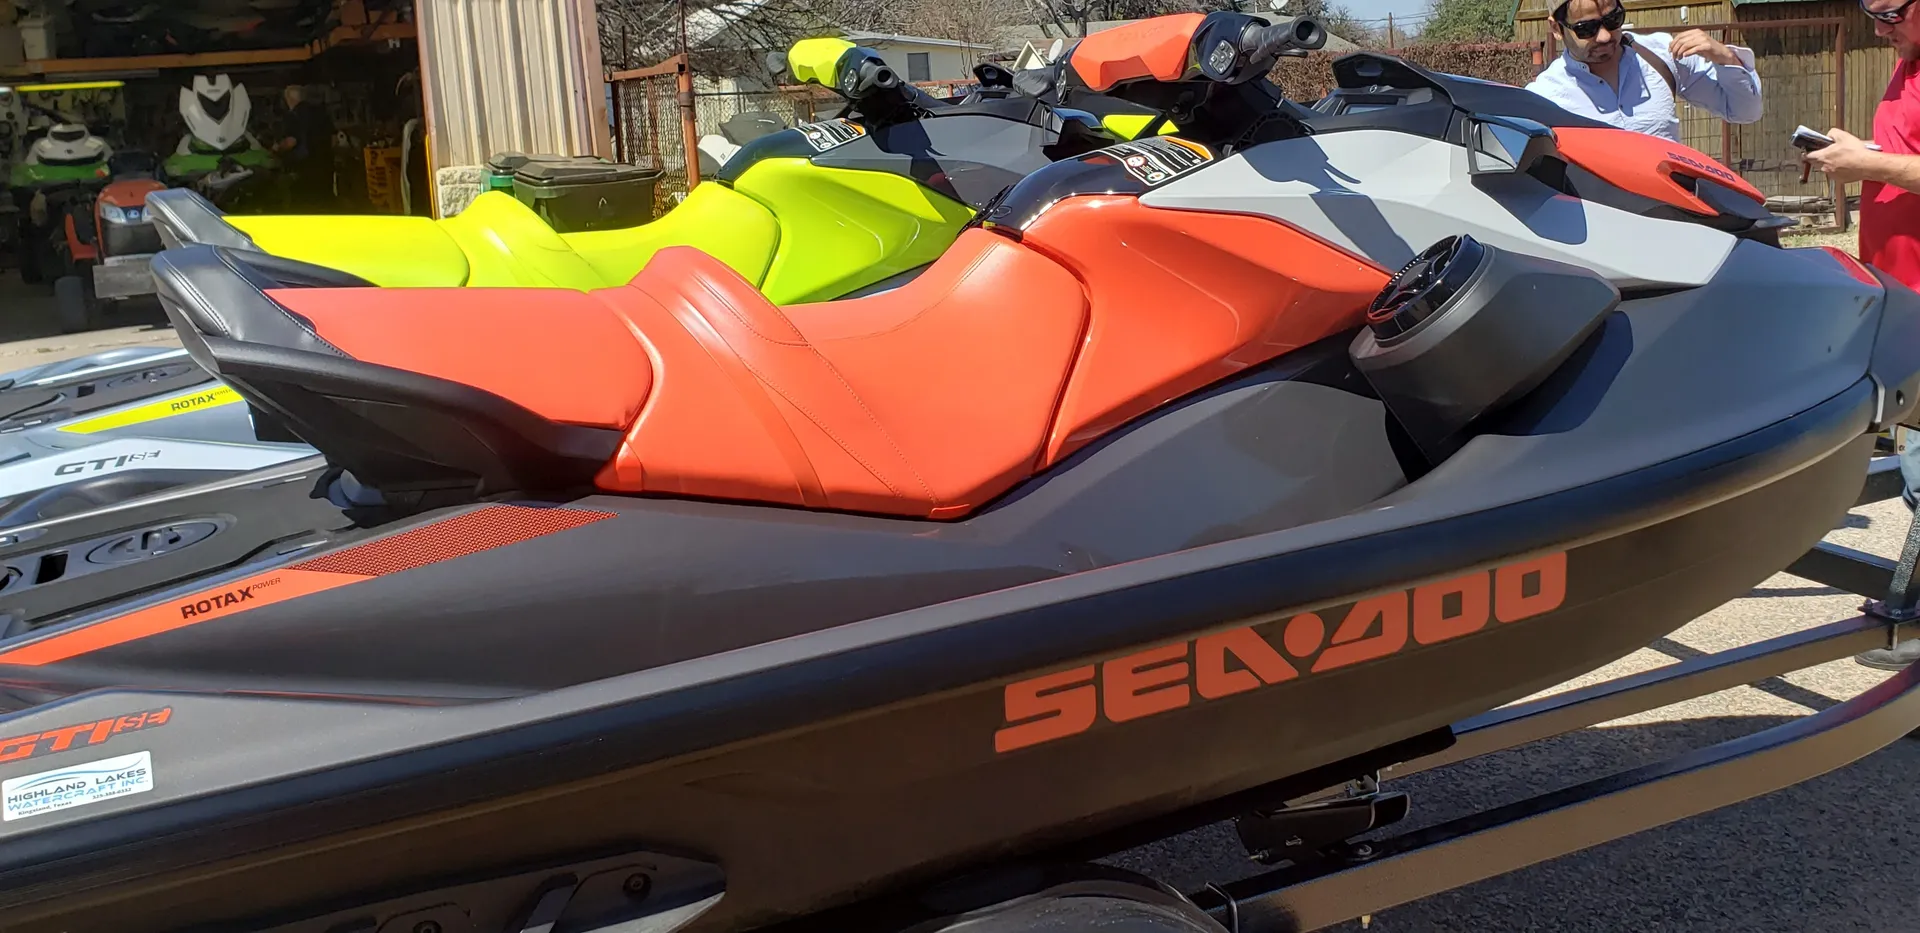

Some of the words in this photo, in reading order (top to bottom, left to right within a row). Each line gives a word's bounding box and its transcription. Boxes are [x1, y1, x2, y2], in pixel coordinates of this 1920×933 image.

[171, 394, 216, 411] ROTAX
[181, 586, 254, 620] ROTAX
[251, 577, 281, 591] POWER
[8, 781, 86, 804] HIGHLAND
[95, 768, 147, 785] LAKES
[8, 782, 114, 812] WATERCRAFT
[122, 777, 148, 788] INC.
[18, 805, 52, 816] Kingsland,
[53, 800, 72, 809] Texas
